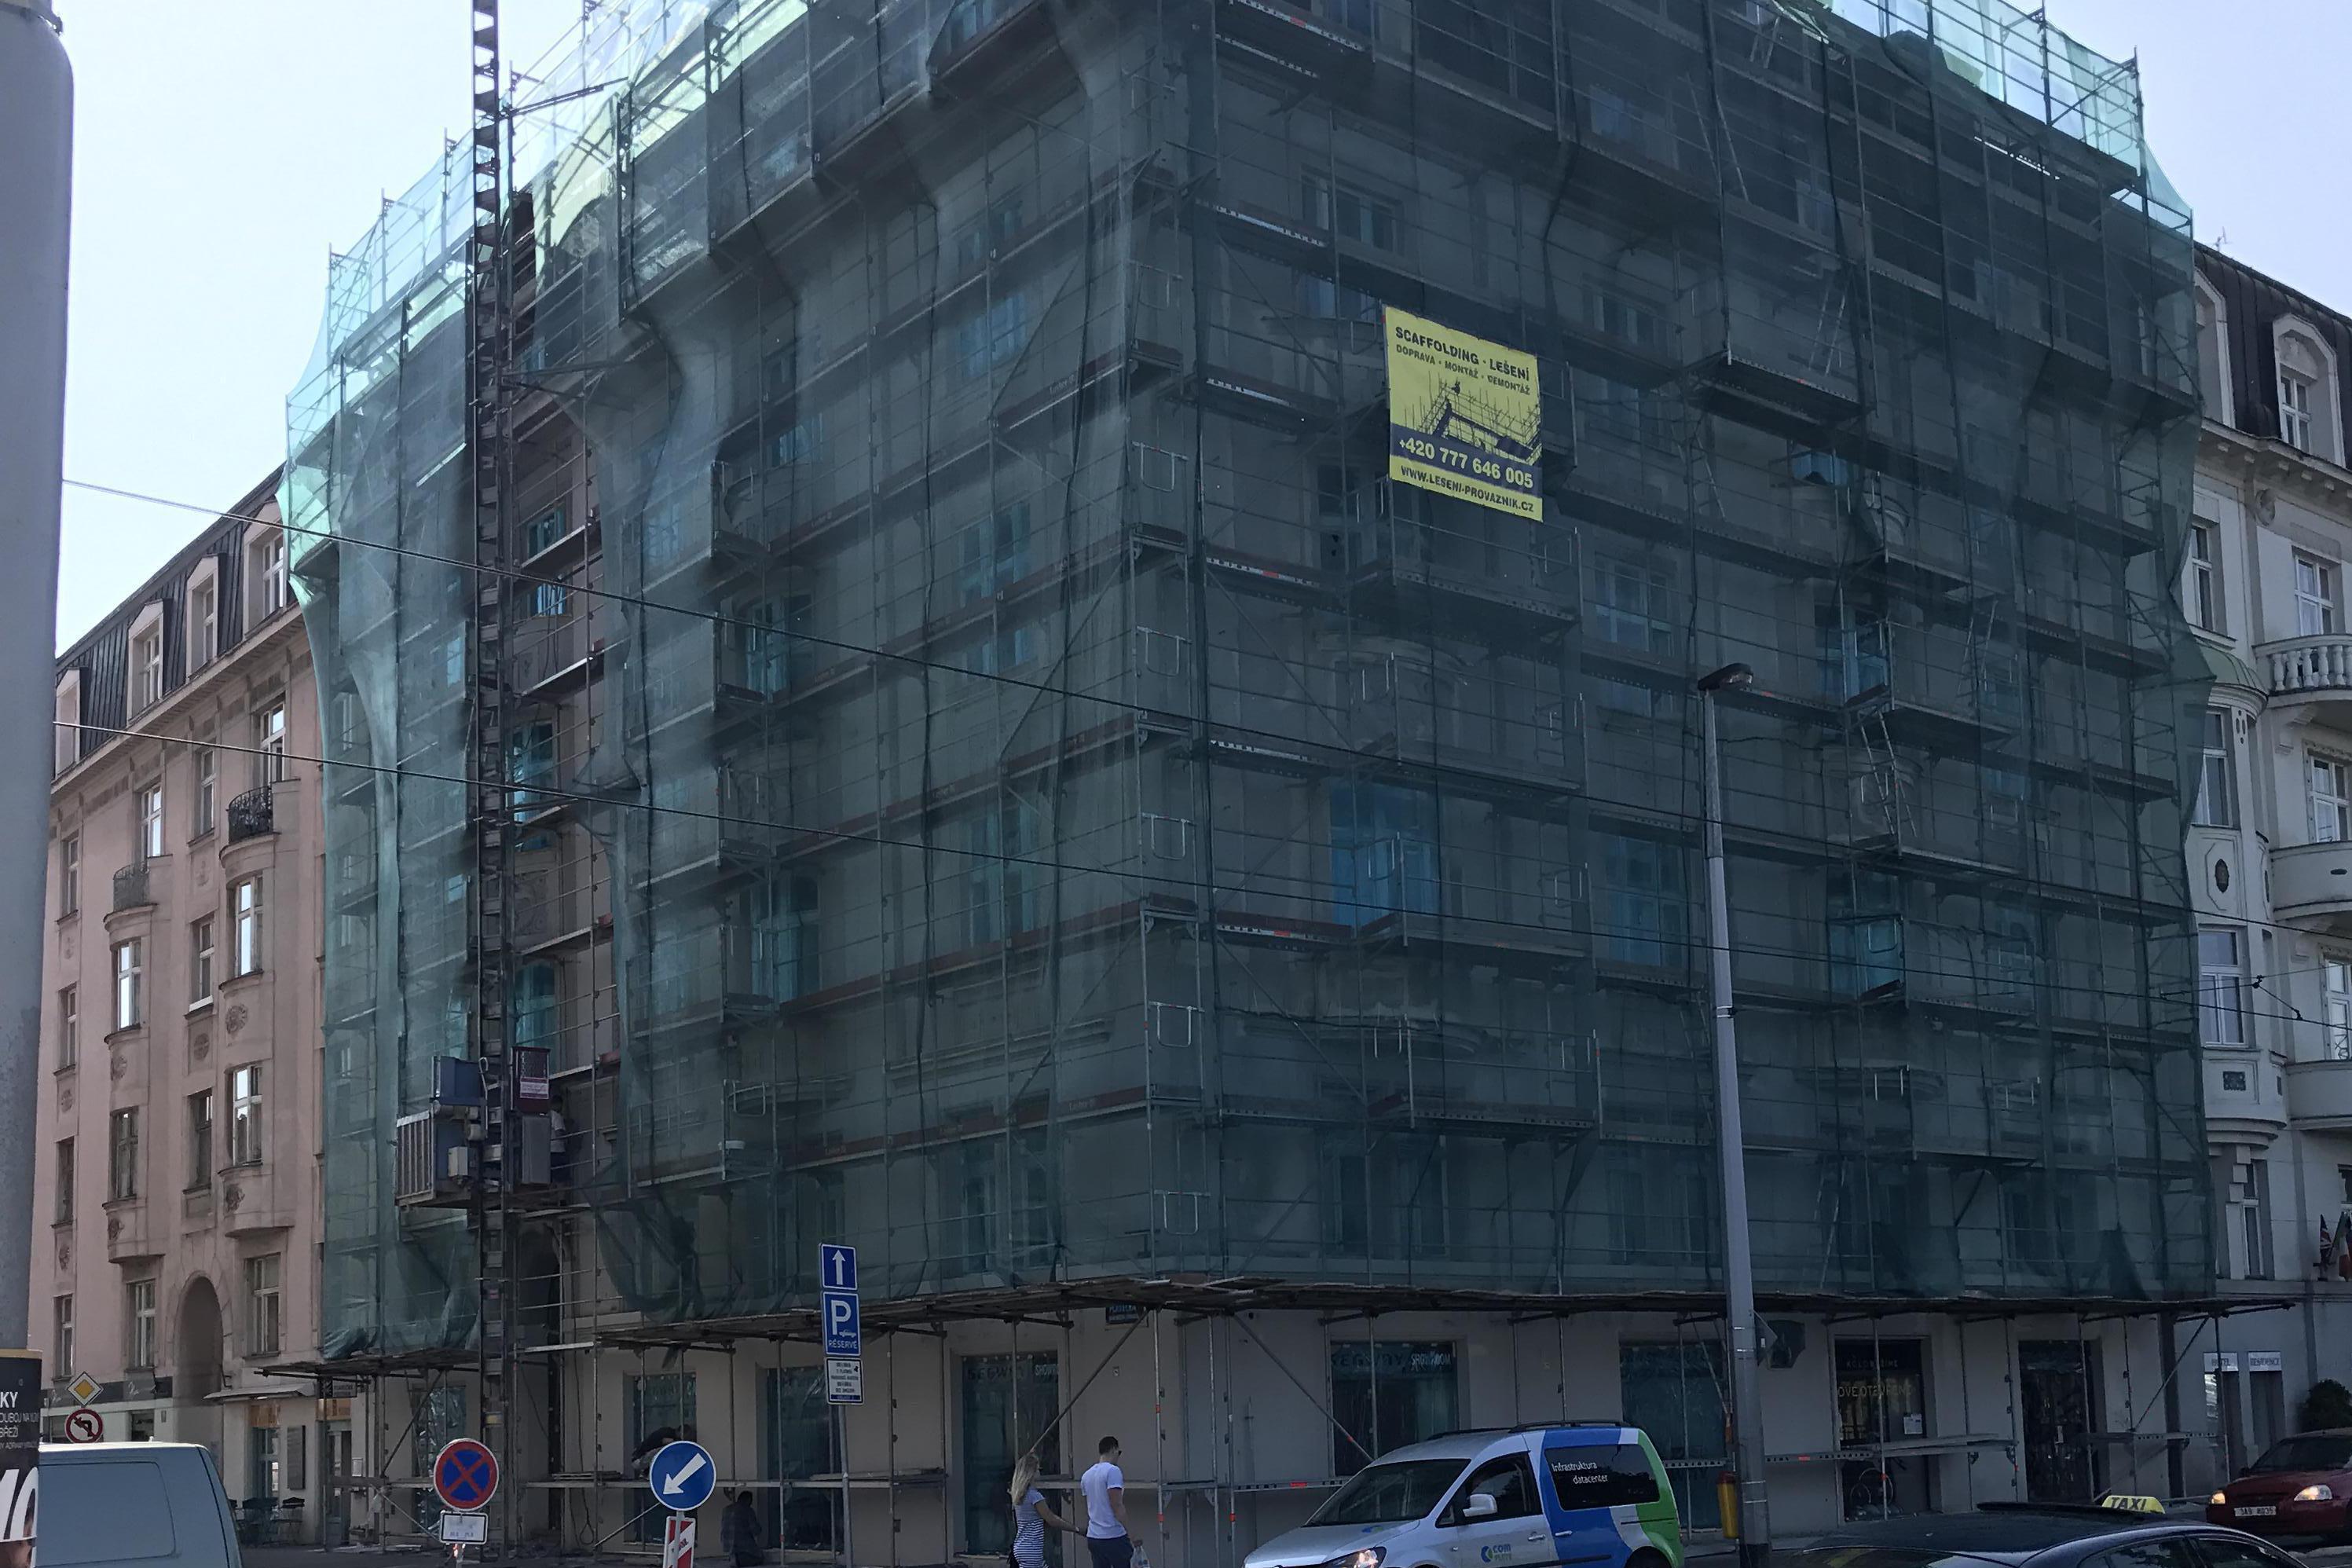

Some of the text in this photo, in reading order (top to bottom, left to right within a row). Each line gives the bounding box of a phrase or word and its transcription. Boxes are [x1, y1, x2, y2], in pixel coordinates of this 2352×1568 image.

[1395, 326, 1529, 381] SCAFFOLDING LEŠENÍ
[1396, 344, 1530, 395] DOPRAVA MONTÁŽ DEMONTÁŽ
[1399, 437, 1533, 489] +420 777 646 005
[1401, 465, 1533, 512] WWW.LESENI-PROVAZNIK.CZ
[830, 1299, 852, 1335] P
[1551, 1461, 1598, 1472] Infrastruktura
[1573, 1475, 1609, 1485] datacenter
[2111, 1497, 2147, 1510] TAXI
